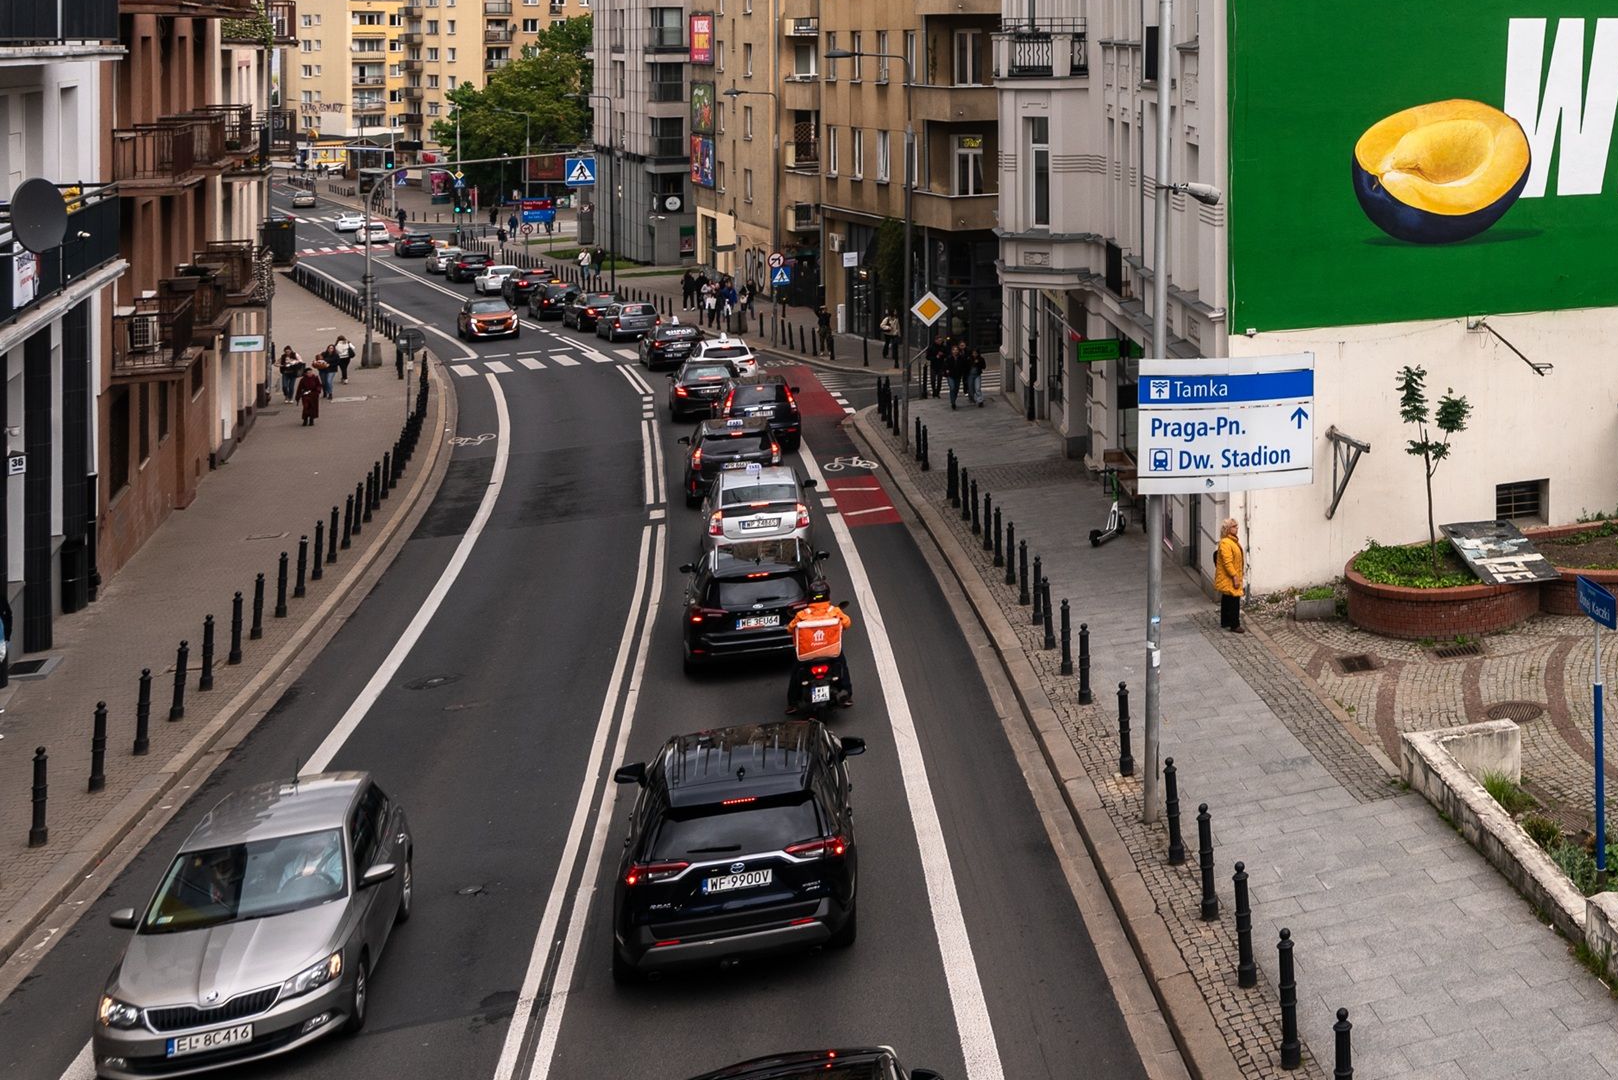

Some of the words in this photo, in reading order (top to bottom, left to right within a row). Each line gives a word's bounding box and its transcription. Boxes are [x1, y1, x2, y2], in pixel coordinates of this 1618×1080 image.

[1174, 379, 1228, 398] Tamka
[1150, 416, 1246, 442] Praga-Pn.
[1178, 450, 1214, 470] Dw.
[1221, 445, 1291, 469] Stadion
[710, 875, 727, 891] WF
[731, 870, 770, 888] 9900V
[176, 1037, 198, 1052] EL
[203, 1024, 249, 1047] 8C416
